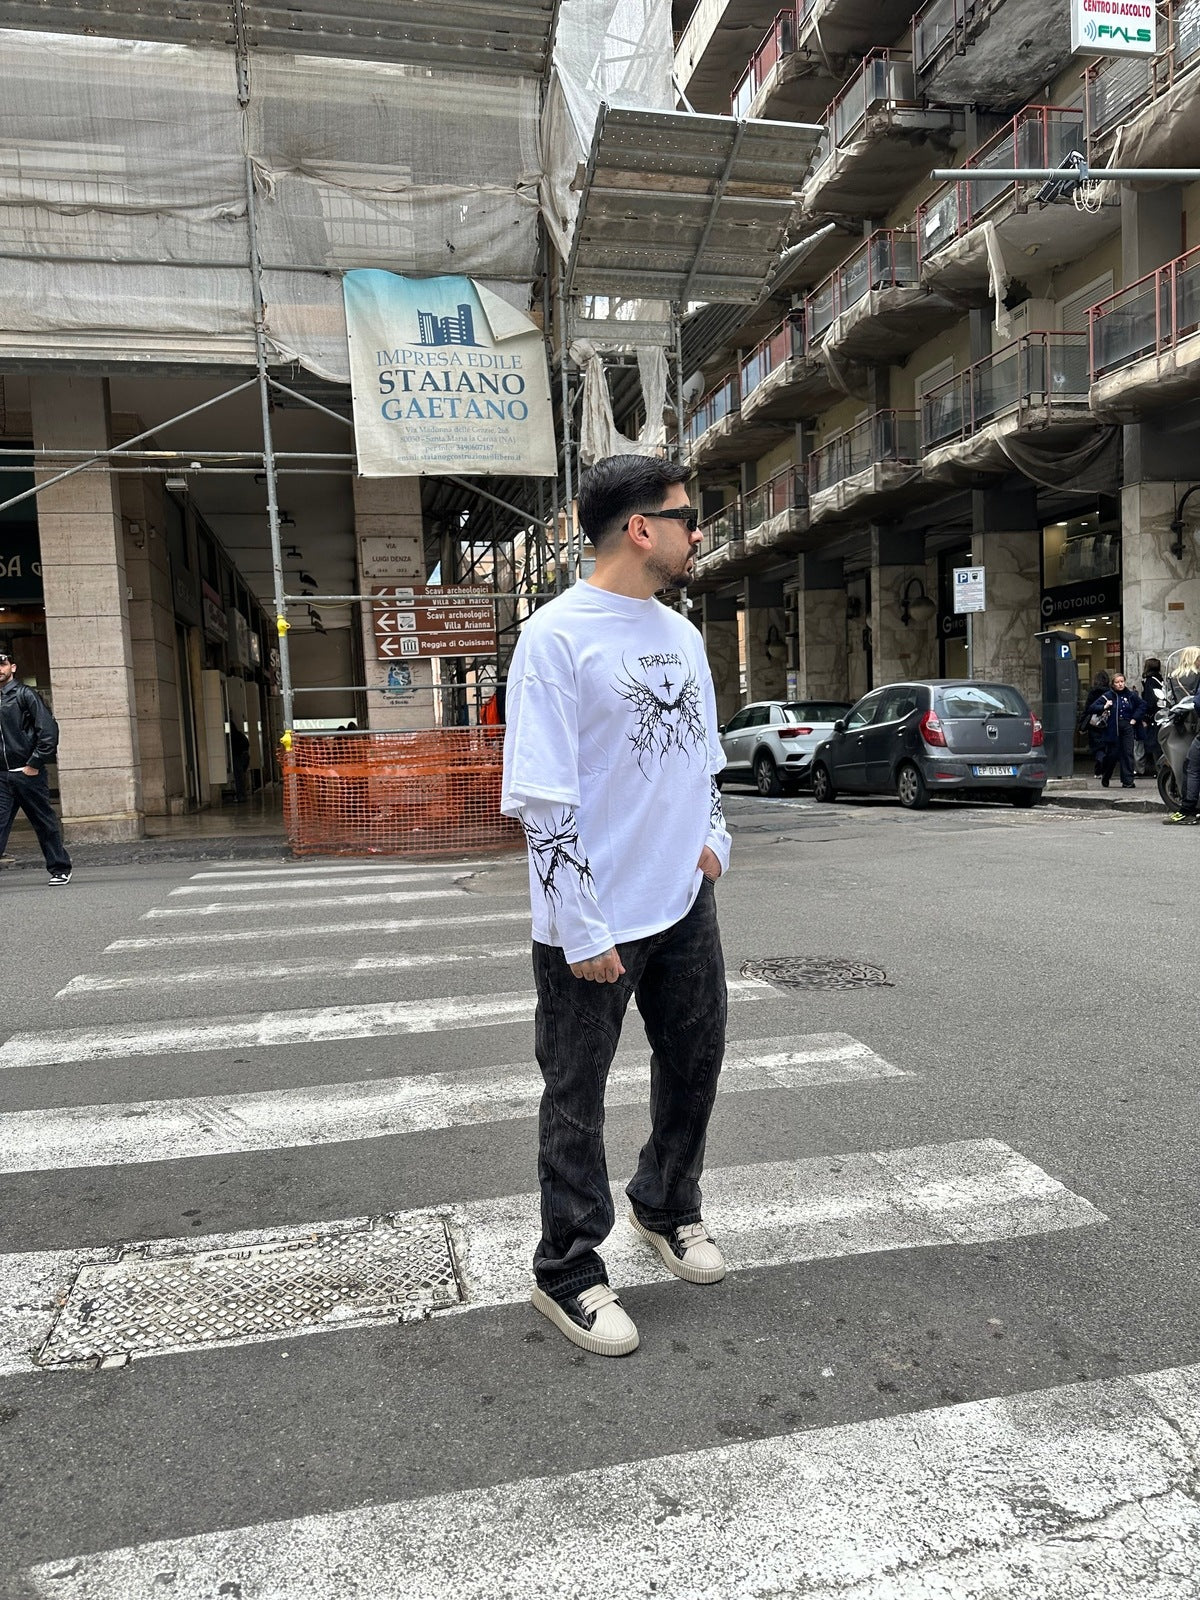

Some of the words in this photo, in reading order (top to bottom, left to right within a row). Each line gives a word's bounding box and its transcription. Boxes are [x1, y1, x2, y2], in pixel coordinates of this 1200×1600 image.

[1083, 0, 1111, 13] CENTRO
[1112, 2, 1119, 14] DI
[1120, 3, 1151, 18] ASCOLTO
[376, 349, 463, 367] IMPRESA
[467, 352, 523, 370] EDILE
[378, 369, 526, 395] STAIANO
[381, 397, 529, 421] GAETANO
[425, 586, 444, 595] Scavi
[447, 585, 489, 594] archeologici
[1041, 593, 1106, 617] GIROTONDO
[426, 611, 446, 620] Scavi
[448, 610, 490, 620] archeologici
[444, 622, 462, 630] Villa
[464, 621, 491, 629] Arianna
[421, 641, 447, 650] Reggia
[448, 640, 457, 648] di
[458, 639, 494, 647] Quisisana
[638, 653, 682, 675] FEARLESS
